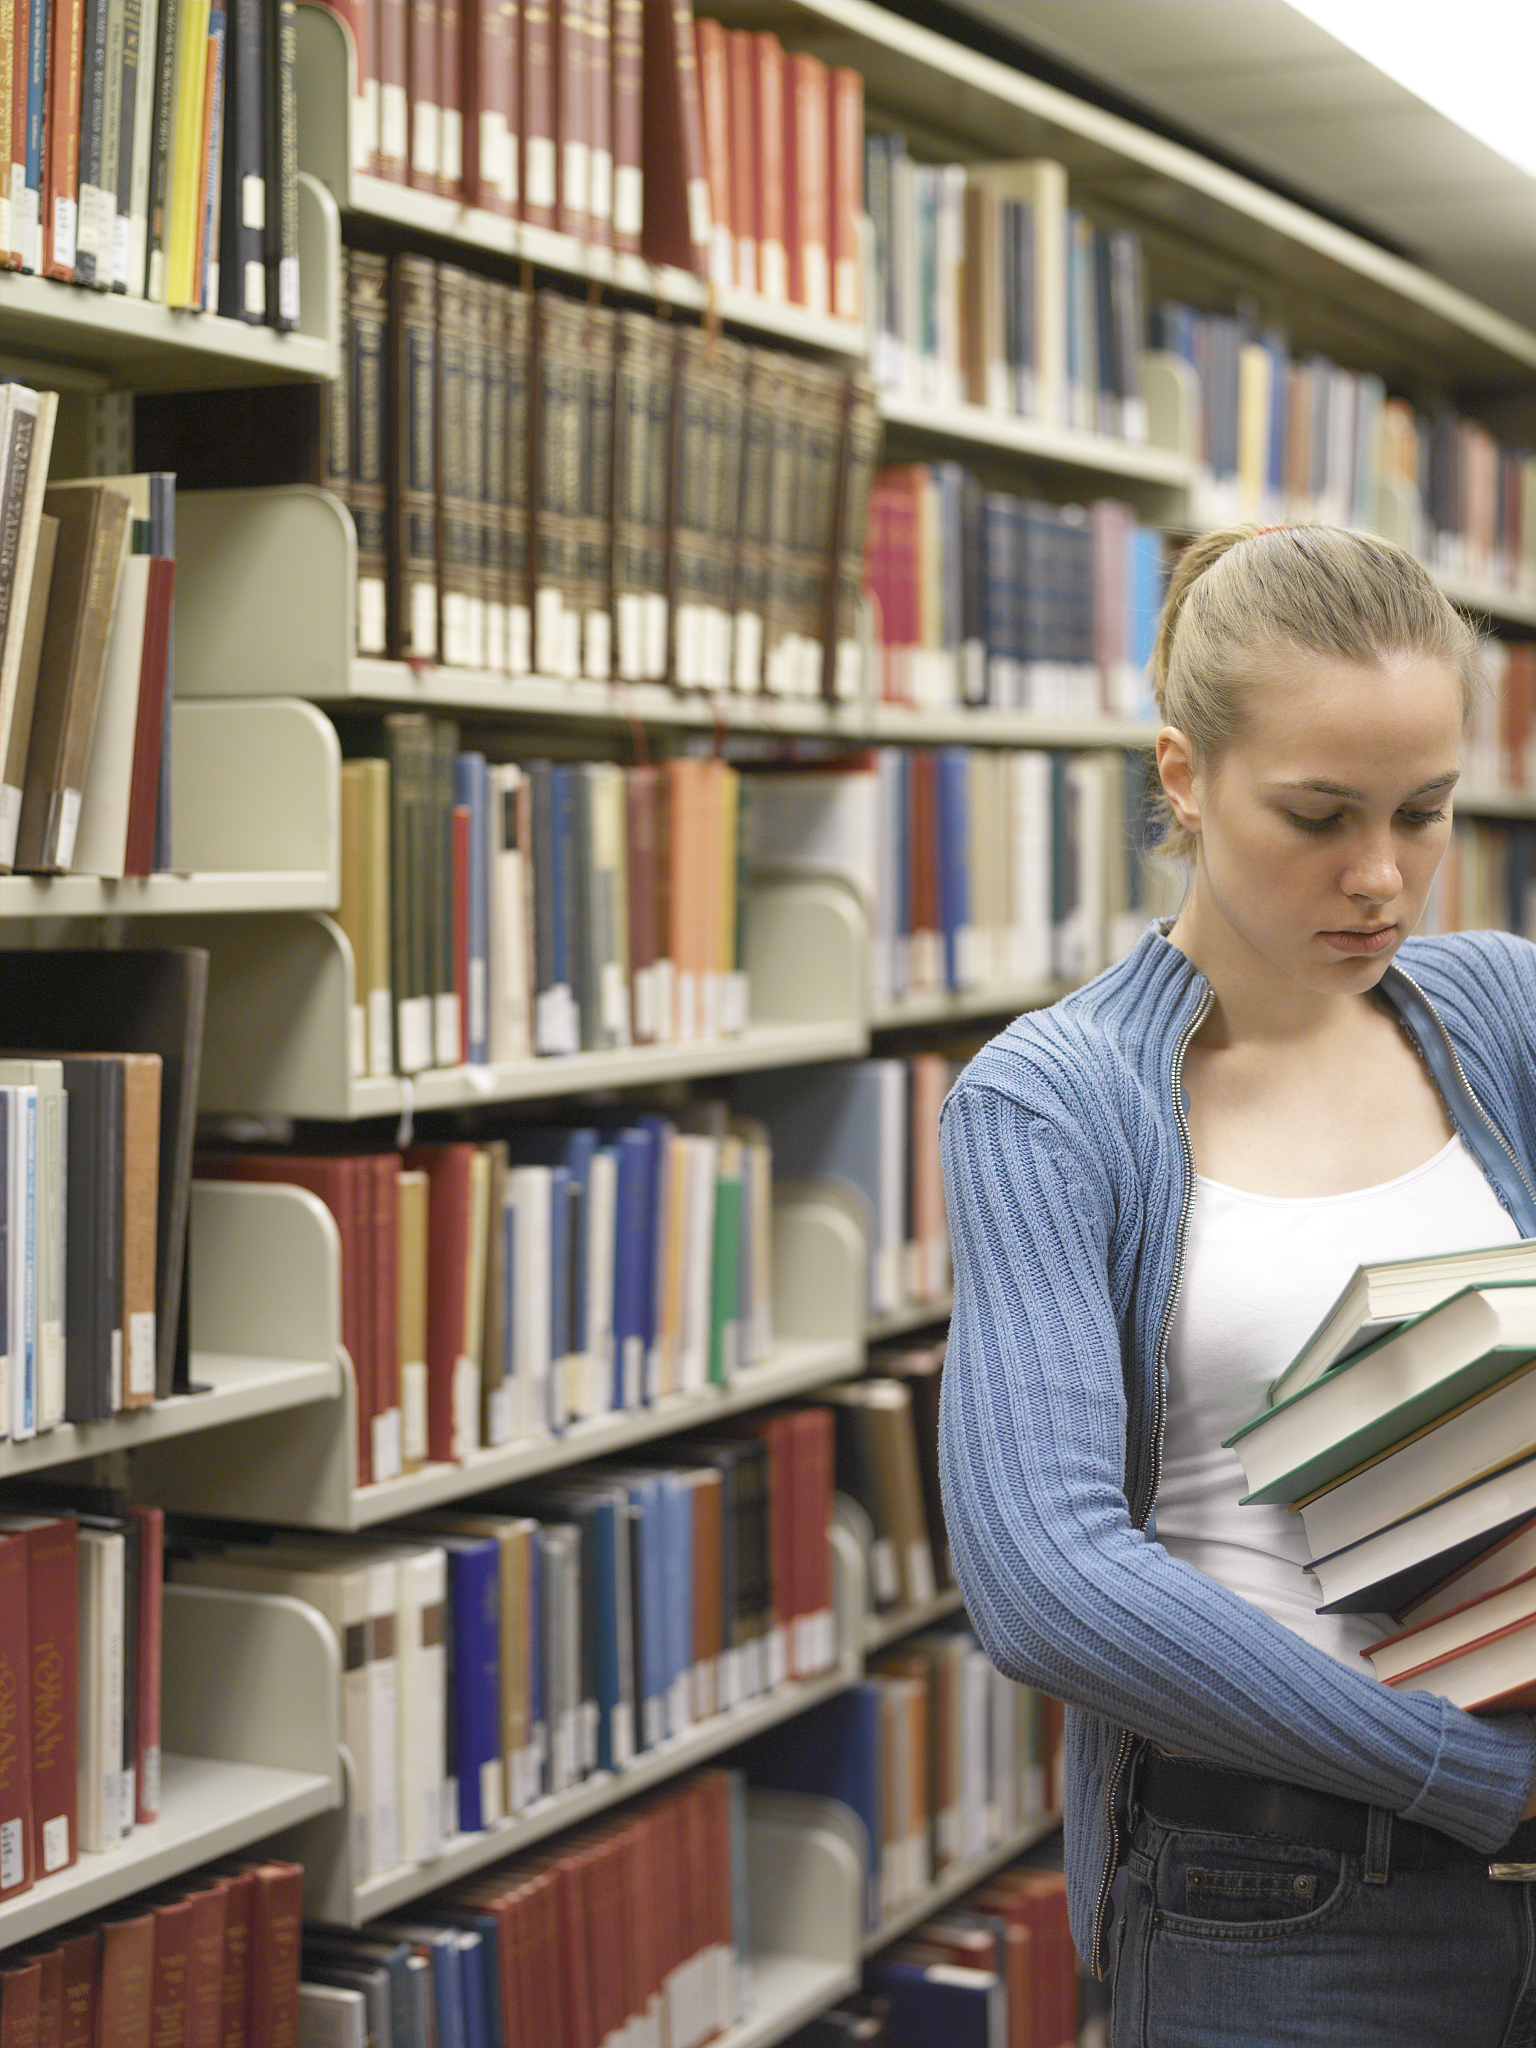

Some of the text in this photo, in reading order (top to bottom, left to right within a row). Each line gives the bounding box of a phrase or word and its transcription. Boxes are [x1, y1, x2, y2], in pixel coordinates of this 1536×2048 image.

[9, 421, 33, 498] YIGAEL
[0, 501, 22, 566] YADIN
[34, 1634, 64, 1771] TORAH
